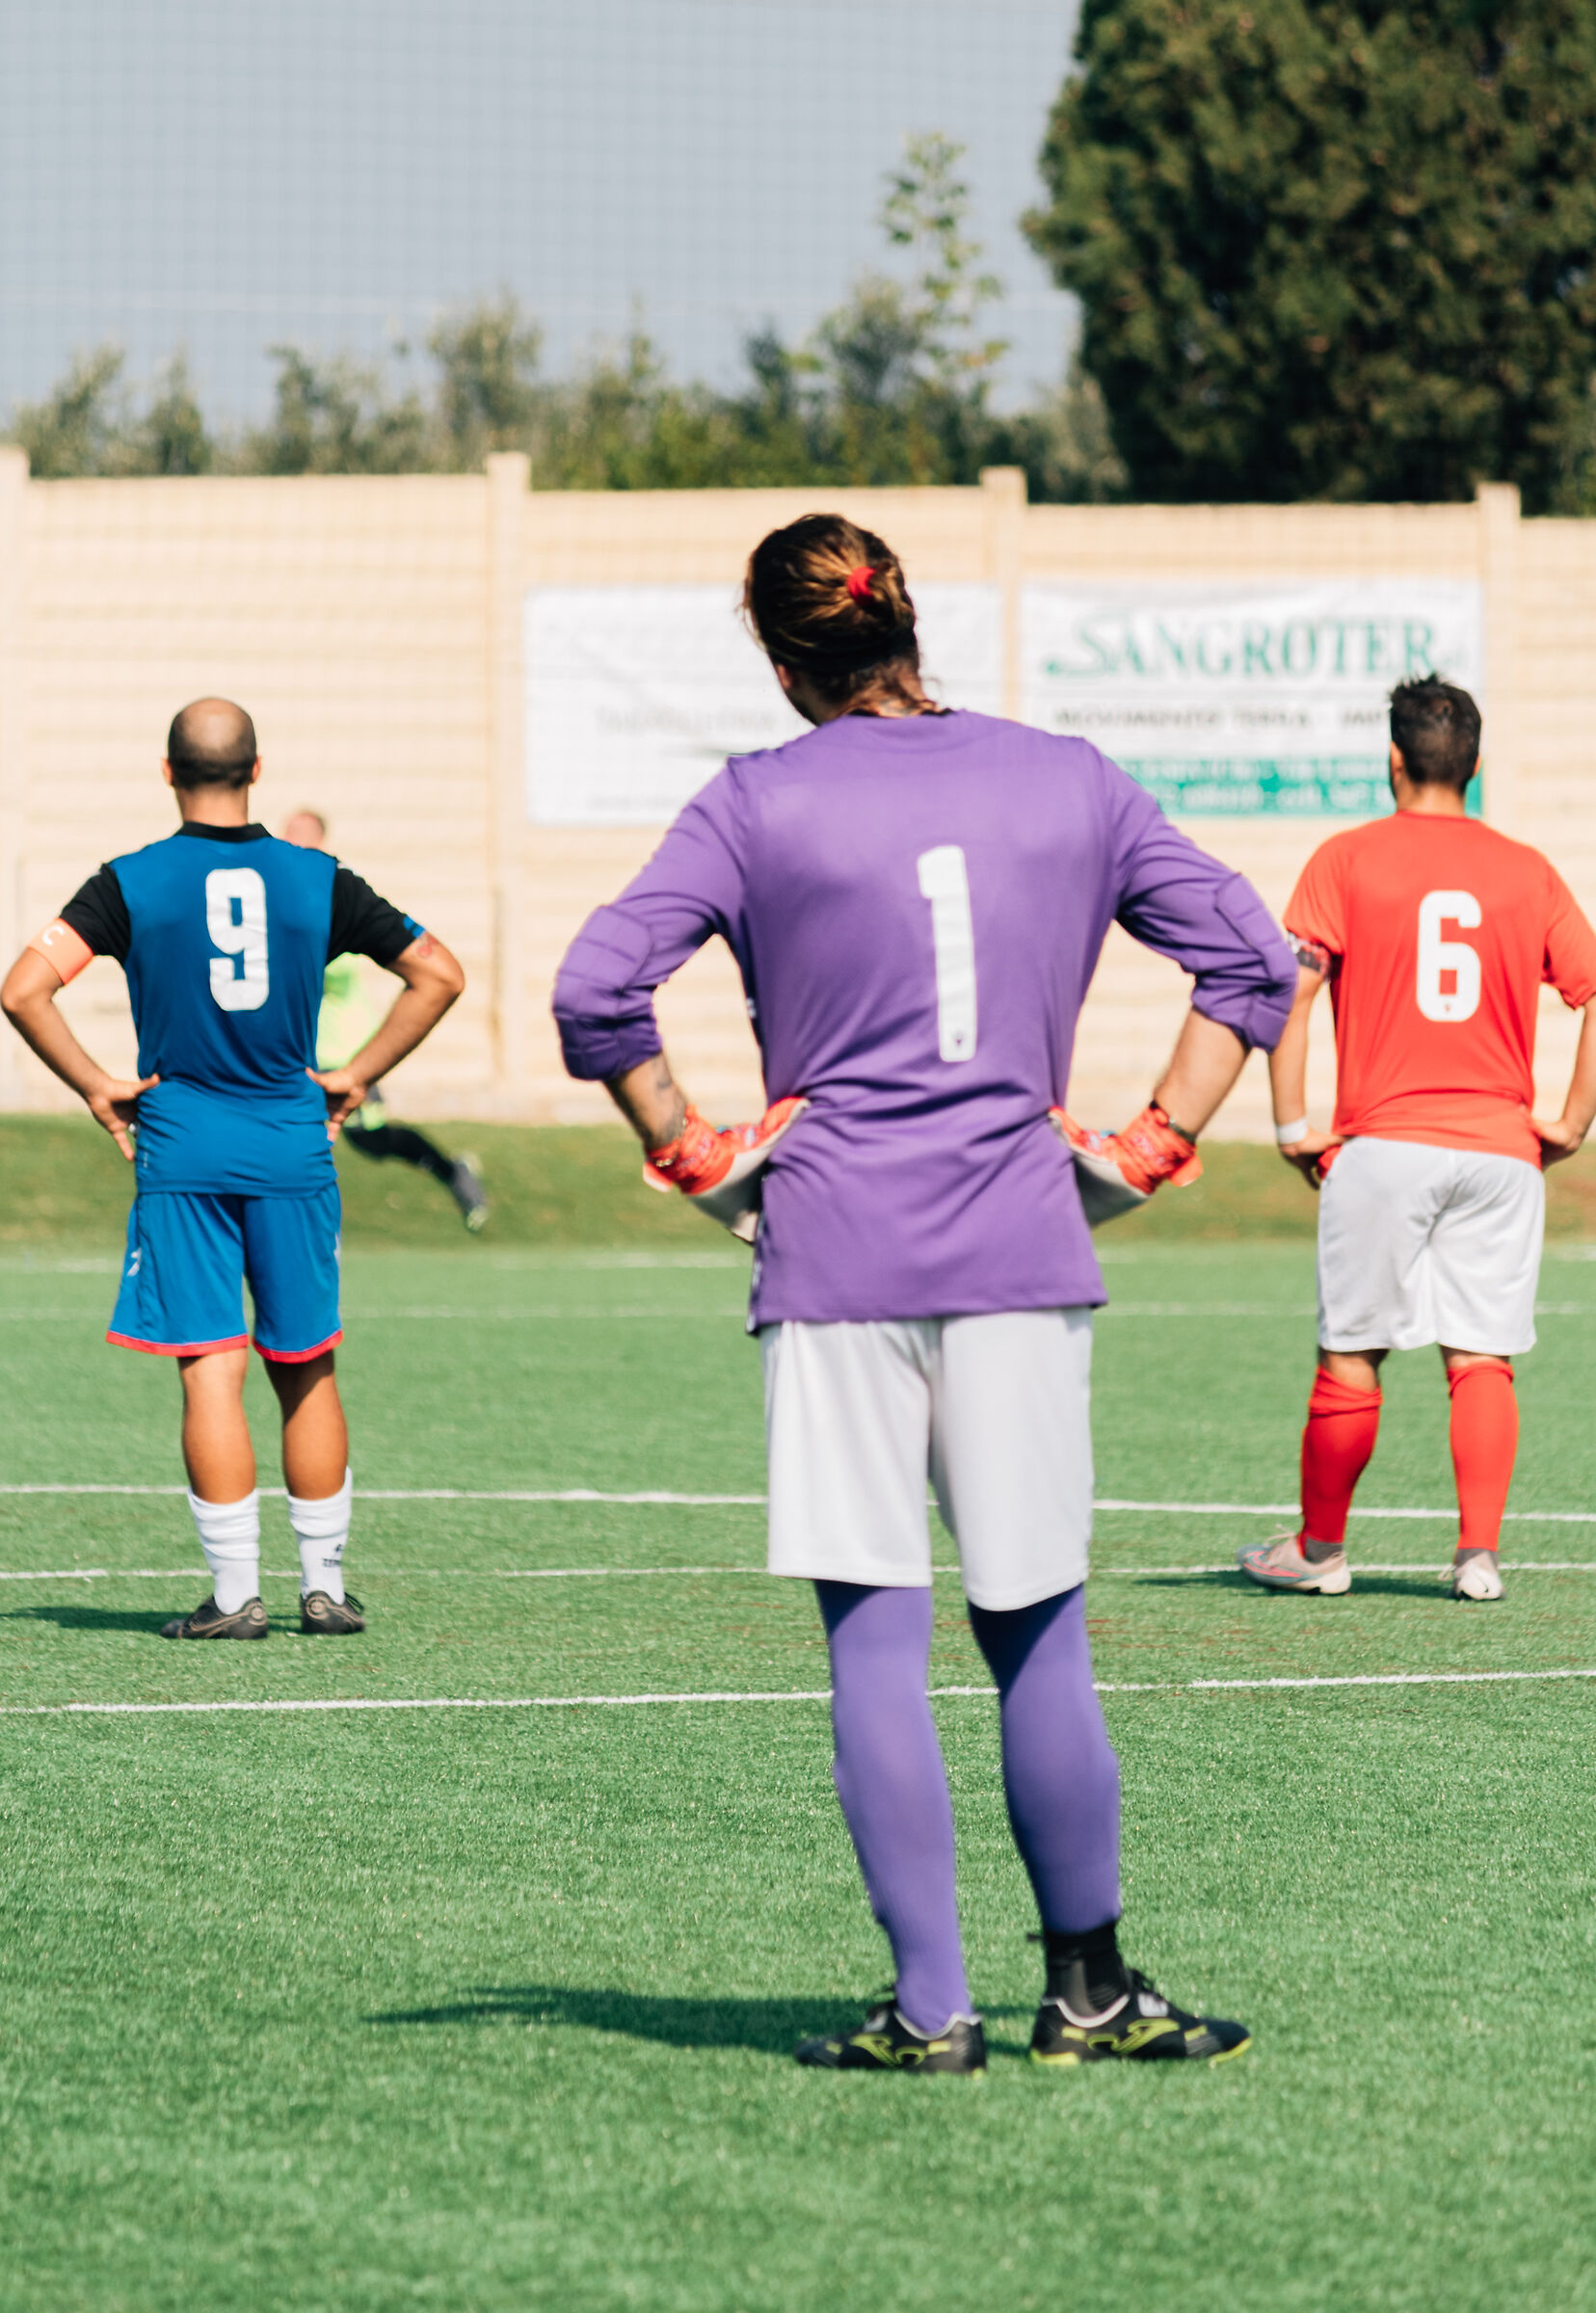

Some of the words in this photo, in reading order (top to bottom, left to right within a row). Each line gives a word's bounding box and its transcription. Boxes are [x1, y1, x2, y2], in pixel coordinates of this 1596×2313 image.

[1044, 612, 1438, 677] SANGROTER
[41, 924, 65, 946] C
[204, 866, 270, 1012] 9
[917, 844, 977, 1063] 1
[1416, 890, 1482, 1023] 6
